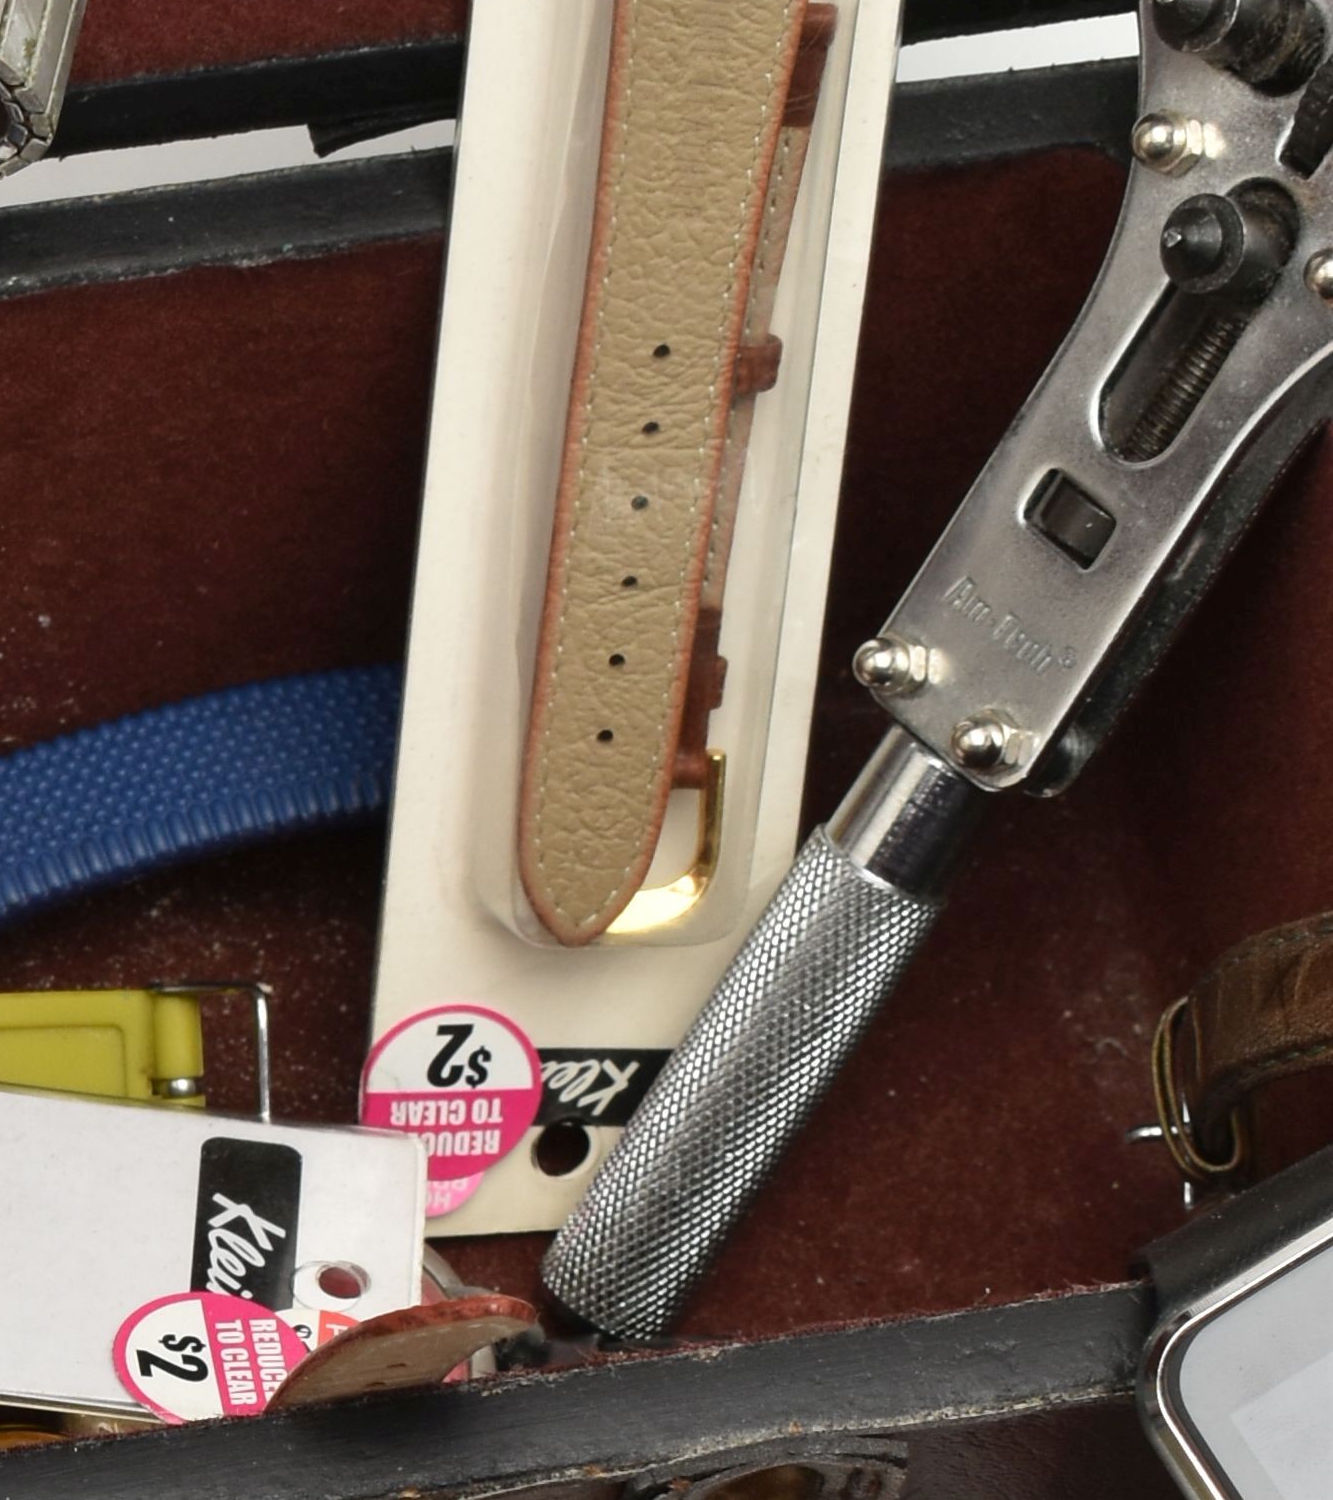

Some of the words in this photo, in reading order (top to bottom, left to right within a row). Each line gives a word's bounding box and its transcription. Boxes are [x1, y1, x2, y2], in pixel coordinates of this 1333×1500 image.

[427, 1023, 492, 1088] $2
[390, 1099, 458, 1127] CLEAR
[467, 1099, 503, 1126] TO
[408, 1129, 500, 1156] REDUC
[213, 1319, 244, 1345] TO
[136, 1333, 210, 1384] $2
[220, 1347, 258, 1407] CLEAR
[248, 1318, 290, 1403] REDUCE
